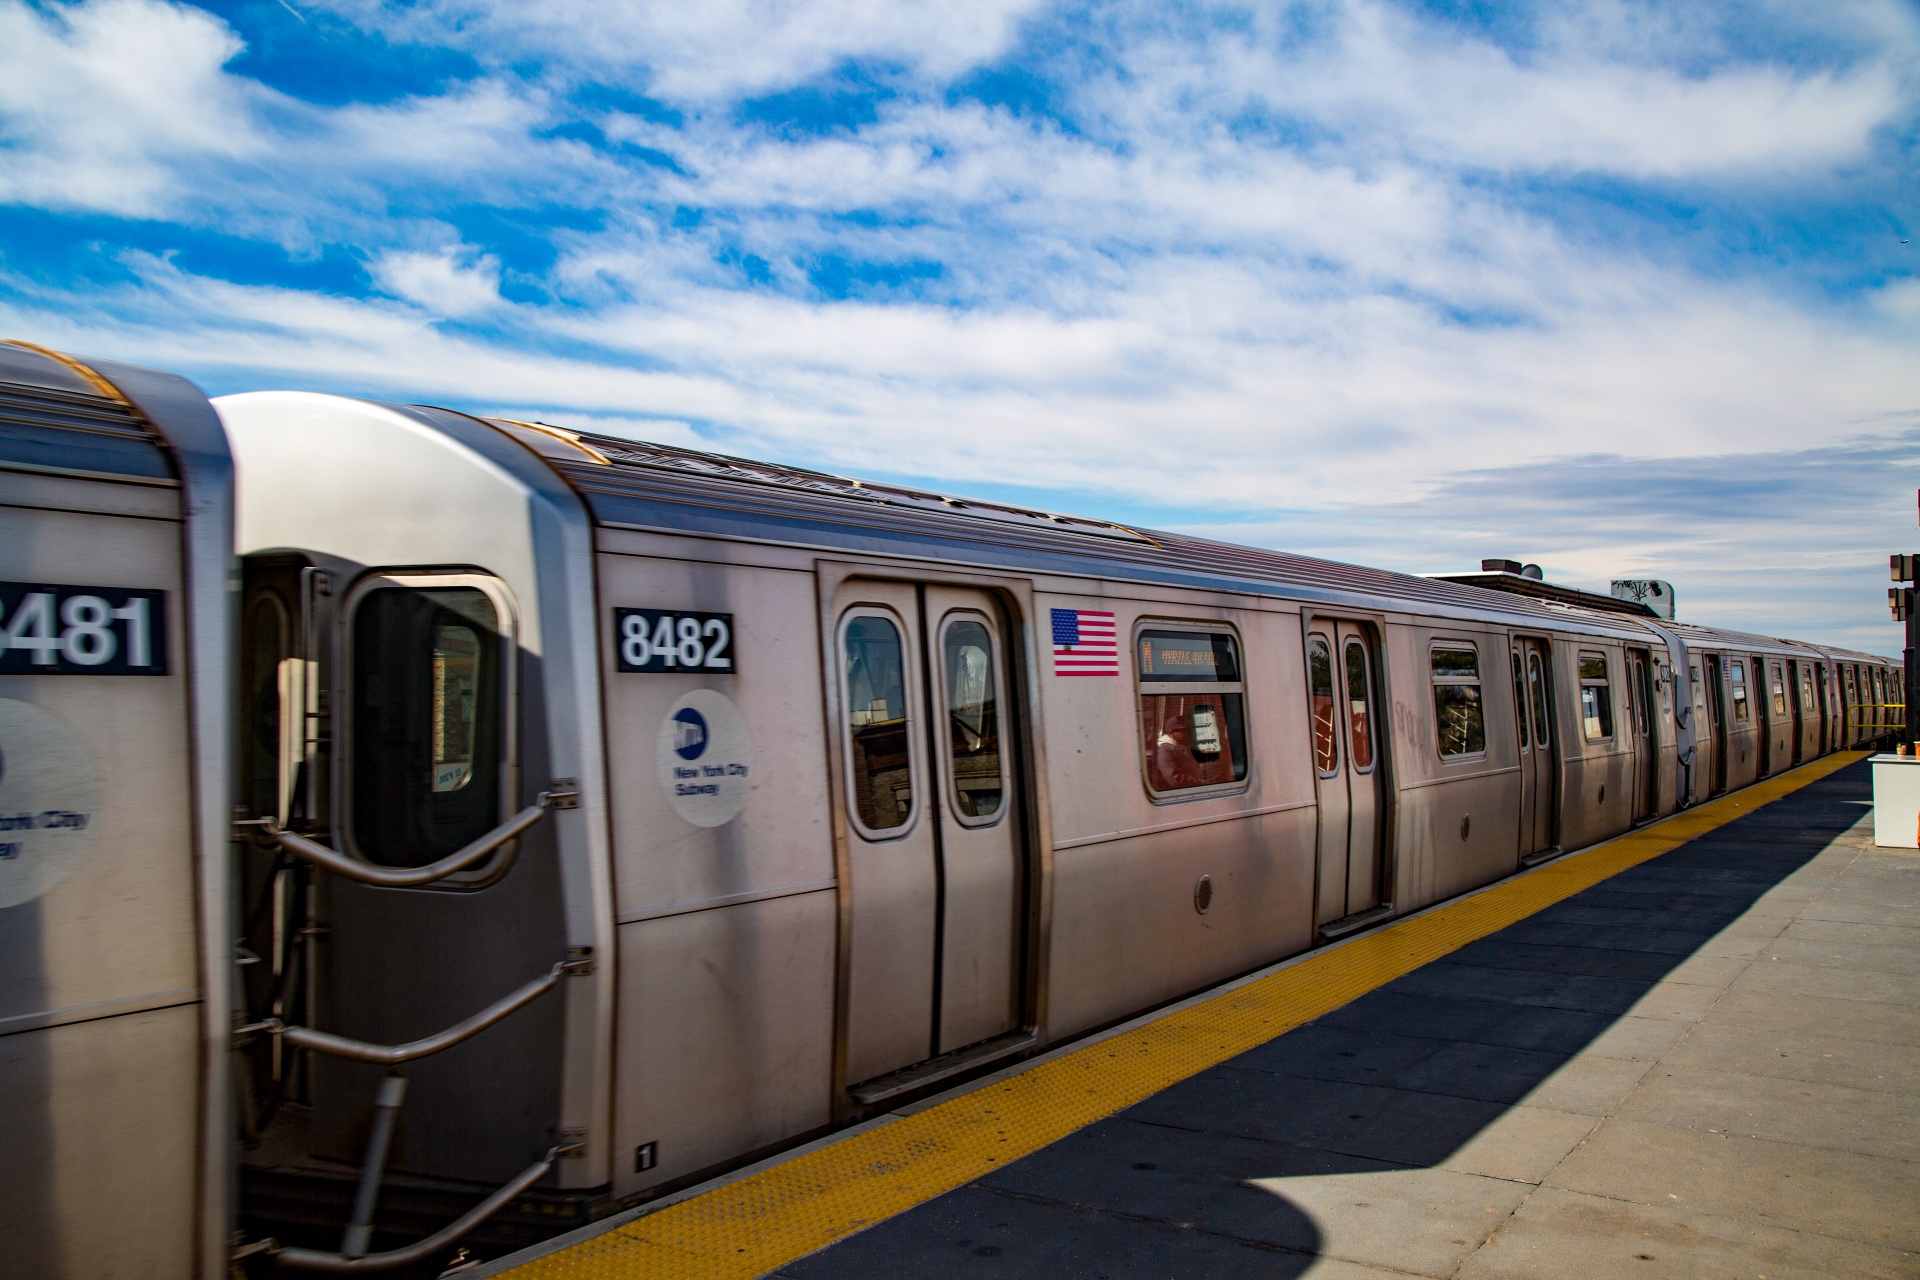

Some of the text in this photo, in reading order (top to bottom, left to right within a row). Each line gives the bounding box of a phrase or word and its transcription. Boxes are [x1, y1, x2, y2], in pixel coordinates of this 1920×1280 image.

[0, 592, 152, 666] 481
[621, 614, 732, 668] 8482
[673, 763, 750, 779] New York City
[674, 783, 720, 796] Subway
[38, 810, 92, 831] City
[639, 1144, 651, 1169] 1
